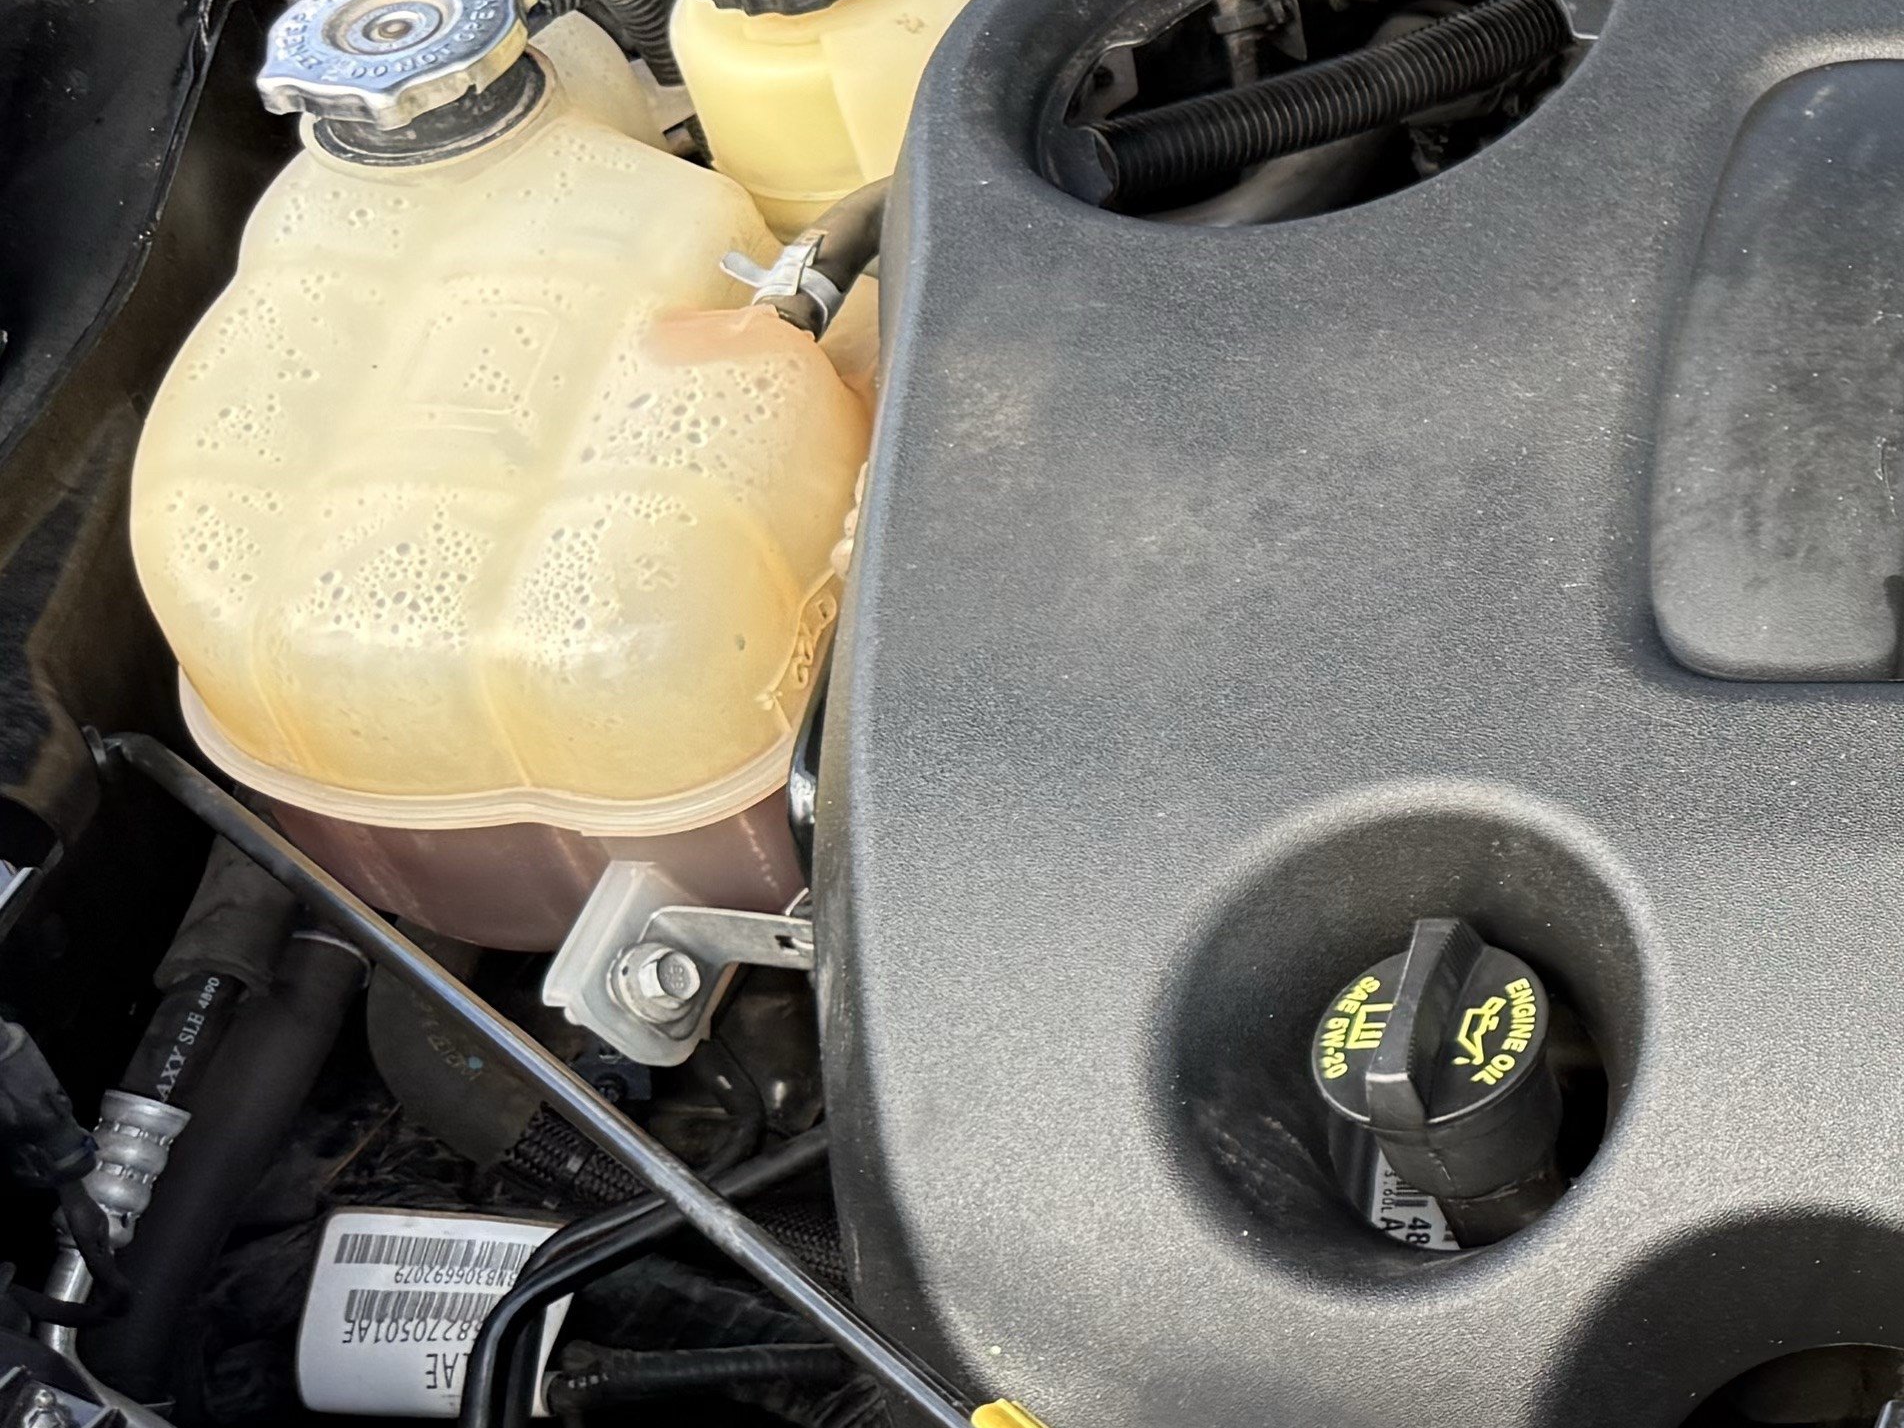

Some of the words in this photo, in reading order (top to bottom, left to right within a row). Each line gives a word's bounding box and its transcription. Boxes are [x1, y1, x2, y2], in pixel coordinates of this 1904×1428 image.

[1336, 976, 1381, 1014] SAE
[1502, 977, 1536, 1053] ENGINE
[1470, 1054, 1515, 1085] OIL
[426, 1353, 470, 1389] AE
